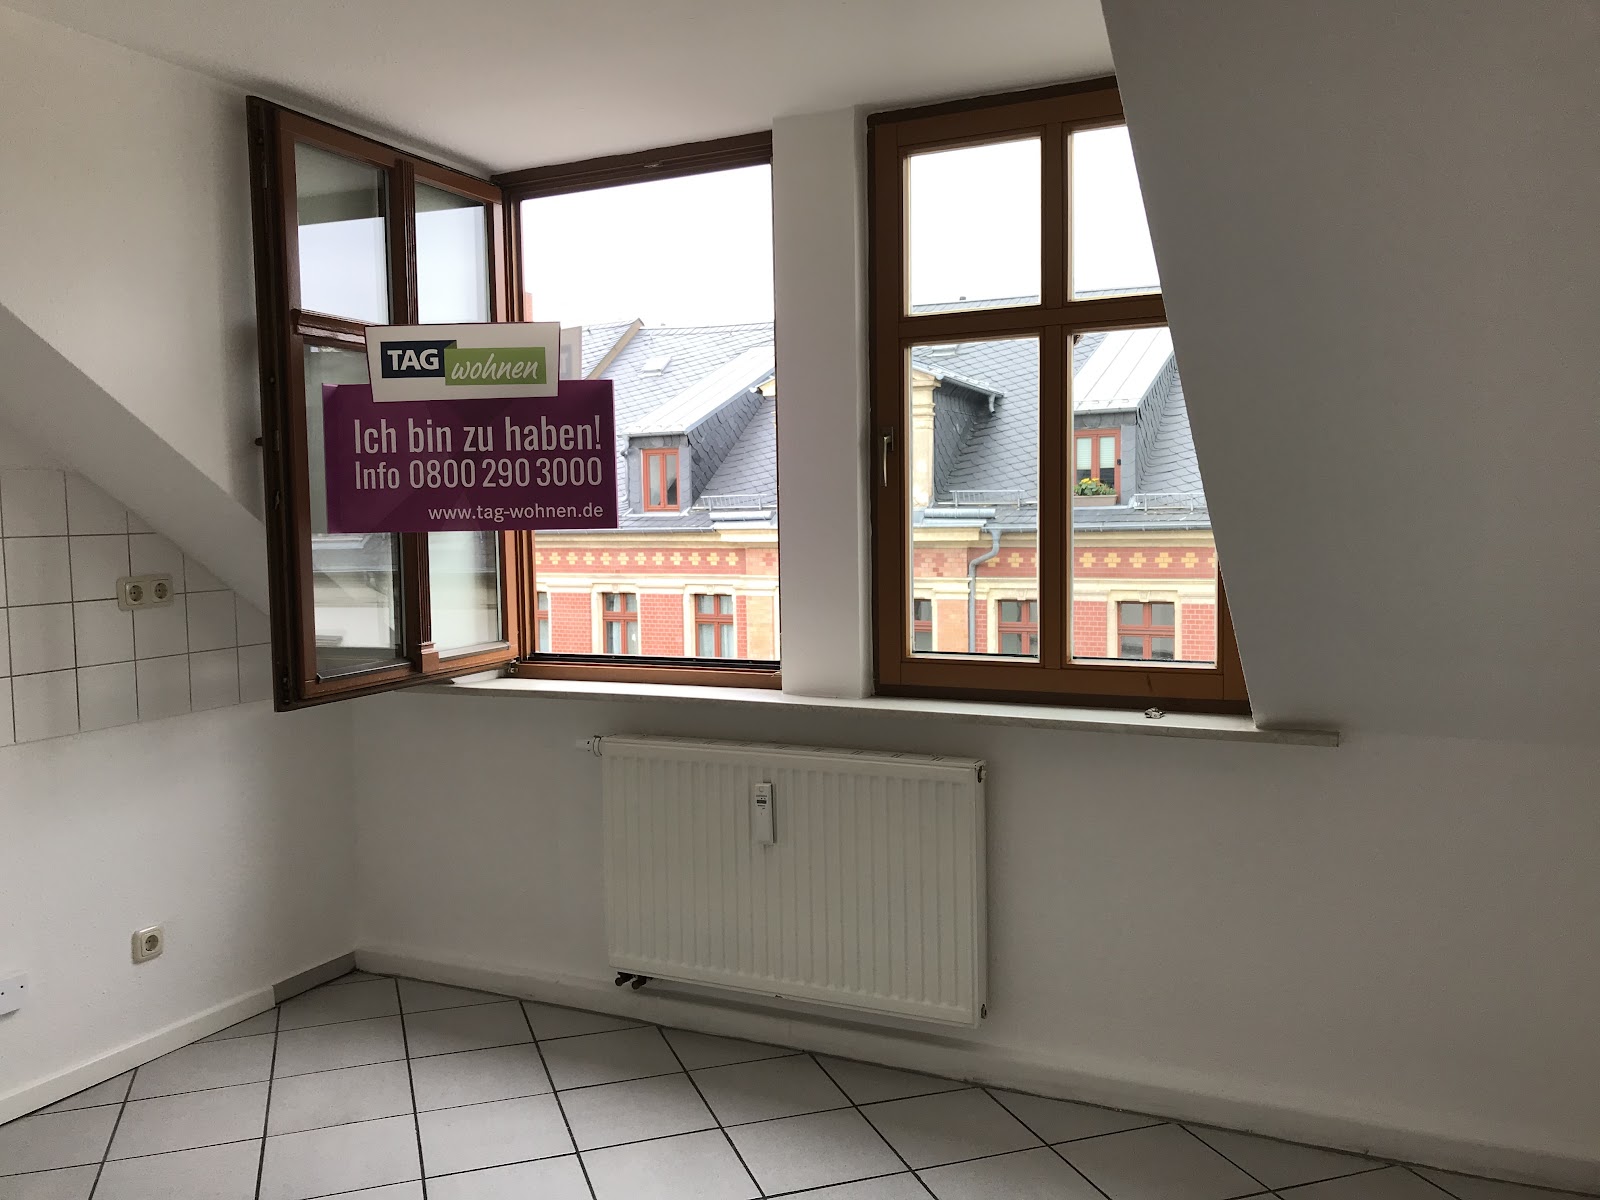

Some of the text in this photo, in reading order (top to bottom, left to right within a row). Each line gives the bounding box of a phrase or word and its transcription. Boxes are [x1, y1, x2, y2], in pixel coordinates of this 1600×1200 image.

[387, 348, 440, 371] TAG
[451, 353, 538, 380] wohnen
[354, 415, 602, 454] Ich bin zu haben!
[355, 457, 603, 490] Info 0800 290 3000
[428, 503, 604, 523] www.tag-wohnen.de
